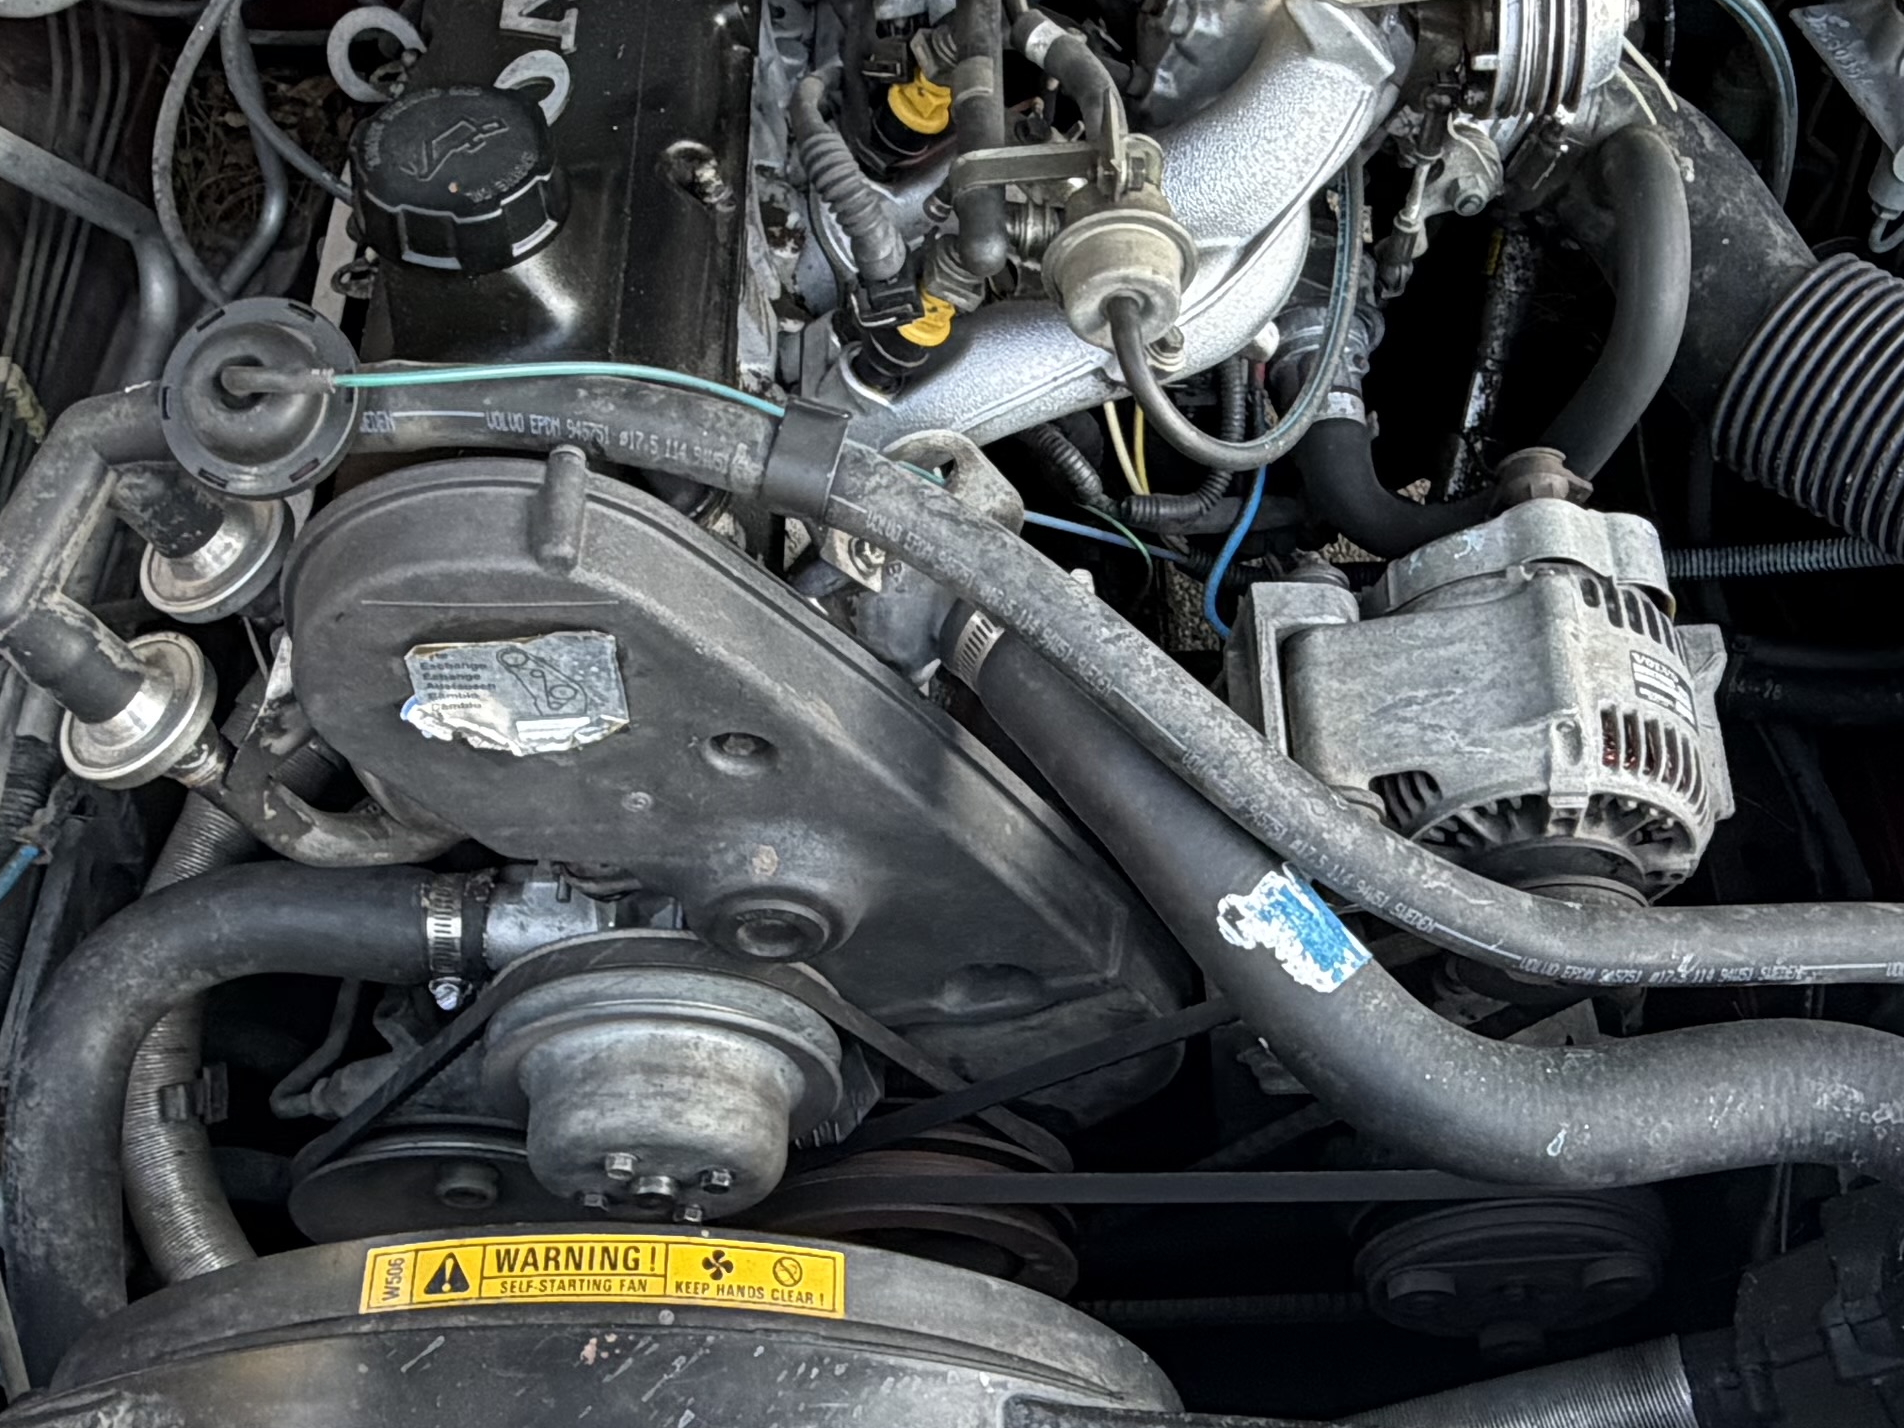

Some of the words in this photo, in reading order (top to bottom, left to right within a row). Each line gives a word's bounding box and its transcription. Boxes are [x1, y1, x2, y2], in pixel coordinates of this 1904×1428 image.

[359, 410, 393, 433] EDEN
[530, 414, 561, 437] EPDM
[1389, 898, 1438, 934] SWEDEN
[380, 1257, 405, 1302] W506
[499, 1277, 614, 1295] SELF-STARTING
[619, 1278, 648, 1294] FAN
[675, 1280, 710, 1296] KEEP
[716, 1282, 765, 1299] HANDS
